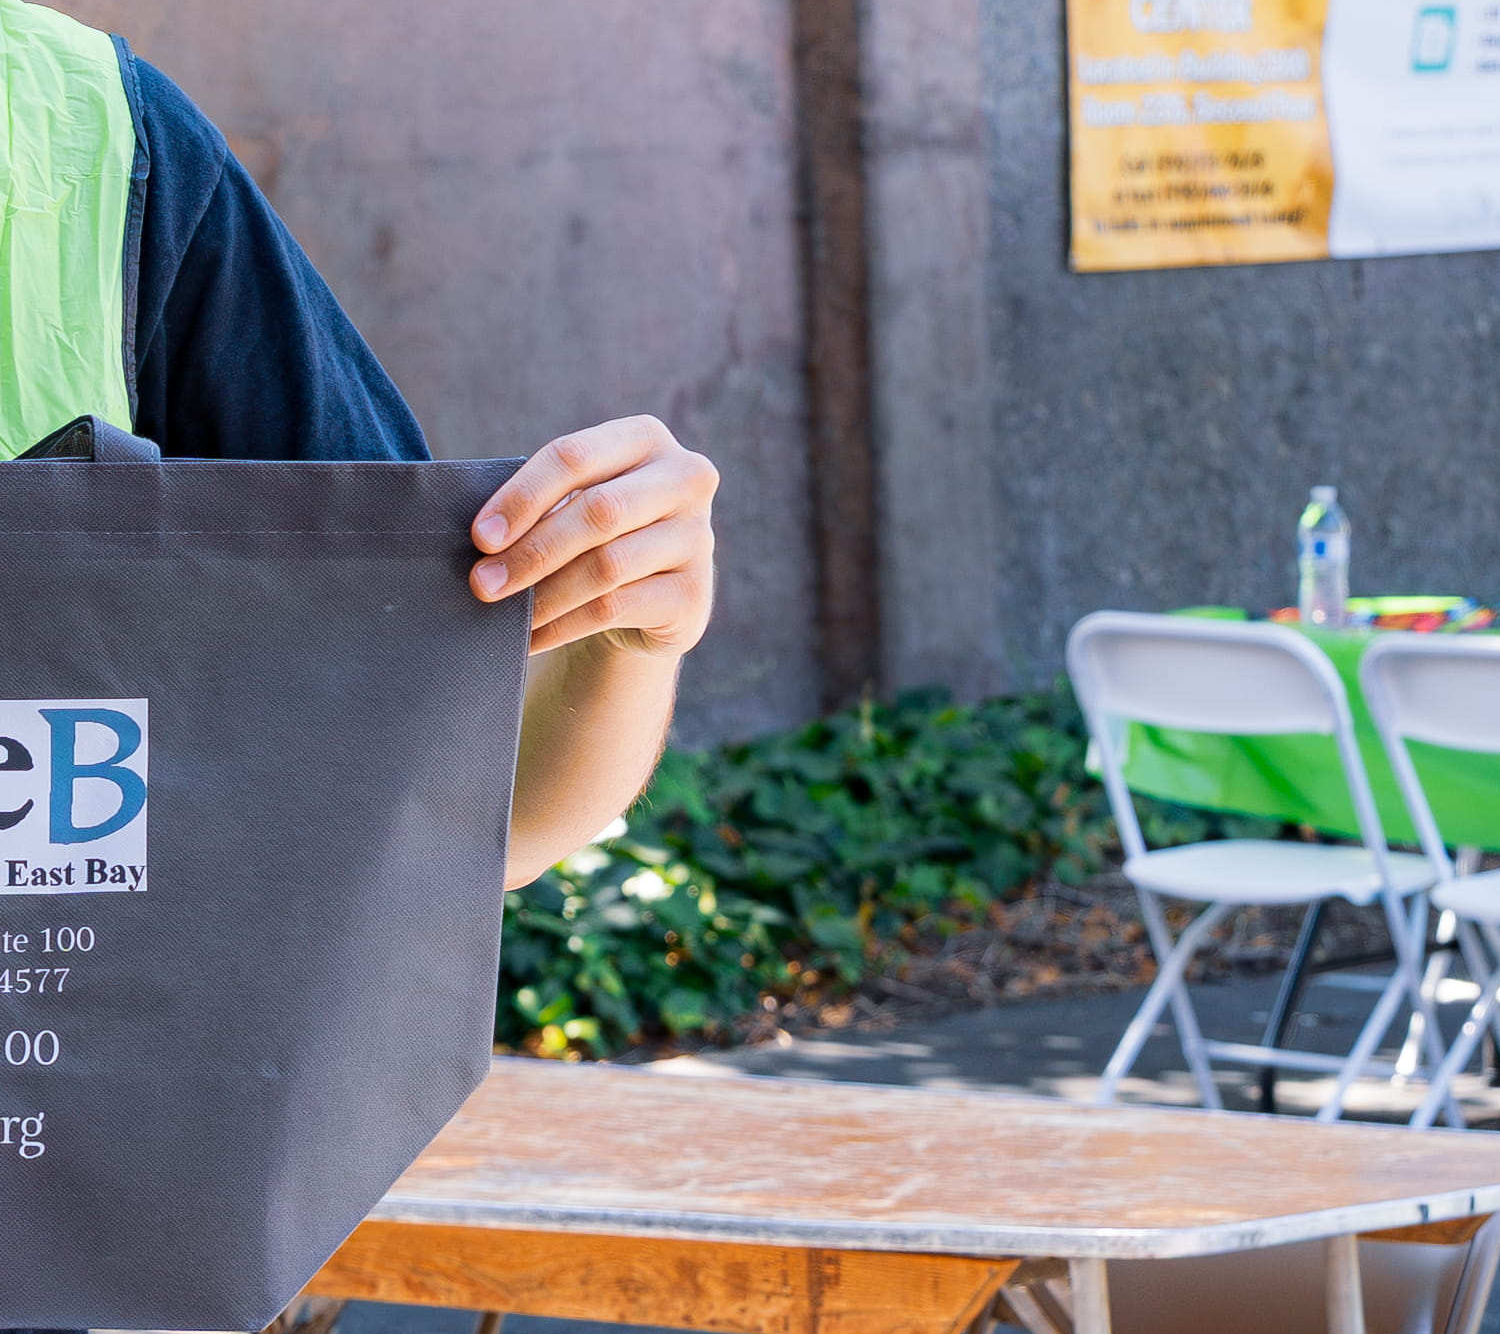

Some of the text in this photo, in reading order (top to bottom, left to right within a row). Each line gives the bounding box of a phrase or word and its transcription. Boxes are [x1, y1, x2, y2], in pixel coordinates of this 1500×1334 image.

[4, 860, 76, 887] East
[85, 858, 146, 892] Bay
[41, 927, 96, 954] 100
